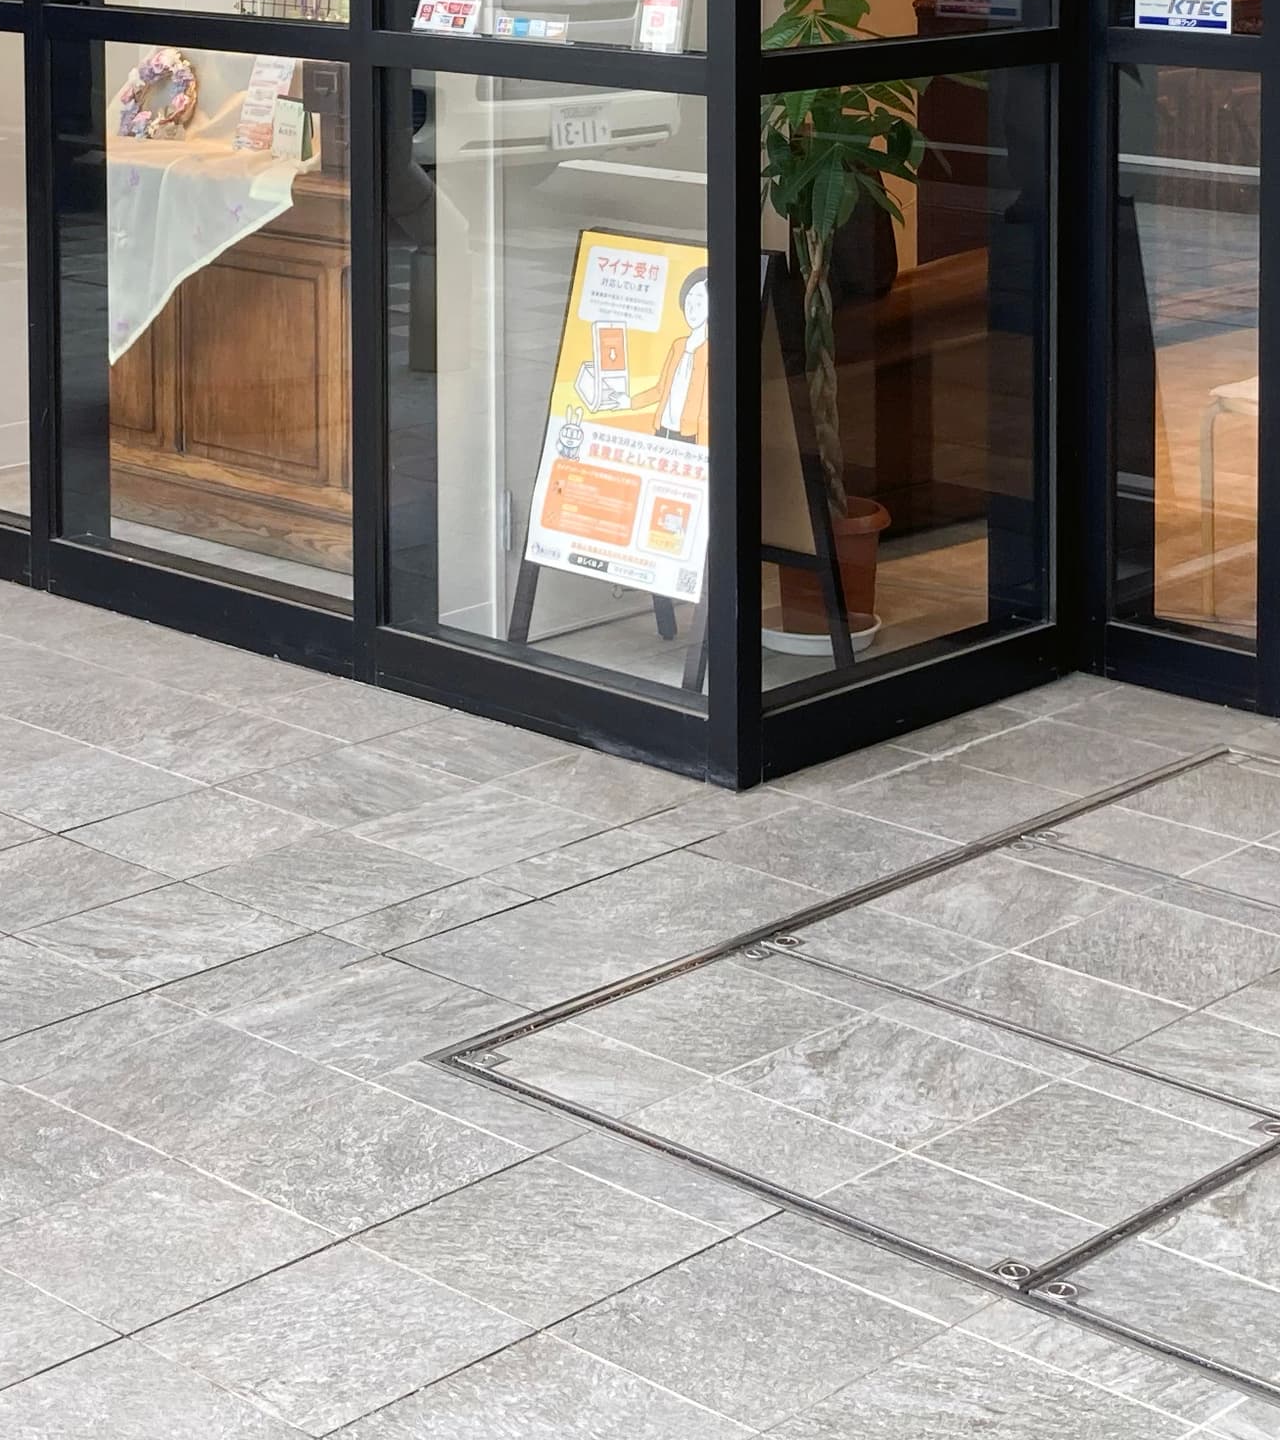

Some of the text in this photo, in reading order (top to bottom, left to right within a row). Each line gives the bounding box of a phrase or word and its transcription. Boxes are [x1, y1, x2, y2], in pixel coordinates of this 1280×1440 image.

[597, 256, 660, 282] マイナ受付
[600, 276, 650, 293] 対応しています
